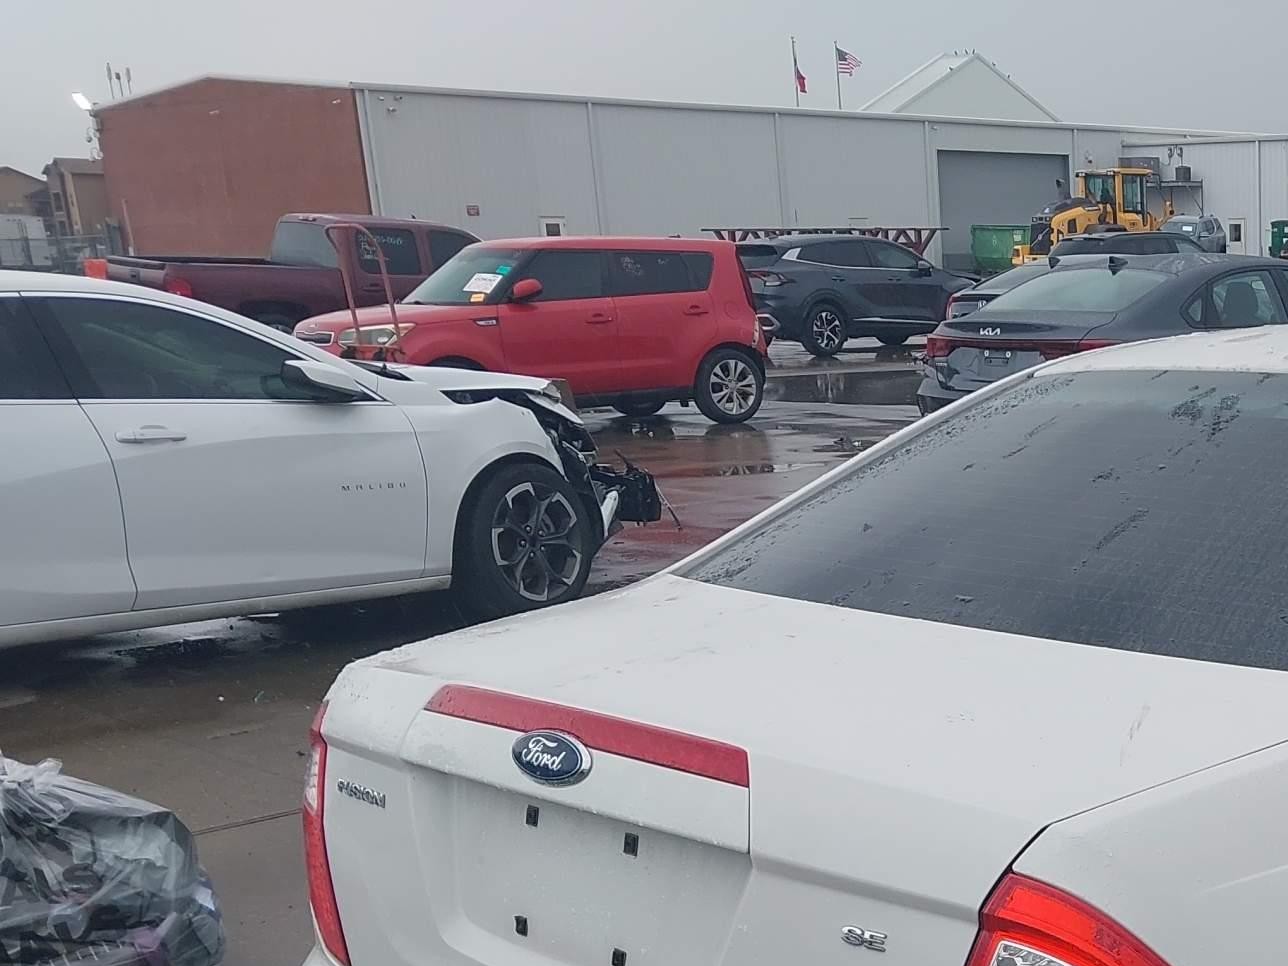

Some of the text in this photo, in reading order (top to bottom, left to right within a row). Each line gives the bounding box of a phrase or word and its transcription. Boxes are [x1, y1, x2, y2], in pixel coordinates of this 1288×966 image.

[980, 327, 1001, 336] KIA
[341, 482, 406, 491] MALIBU
[522, 736, 567, 771] Ford
[337, 778, 386, 809] FUSION
[841, 925, 888, 953] SE
